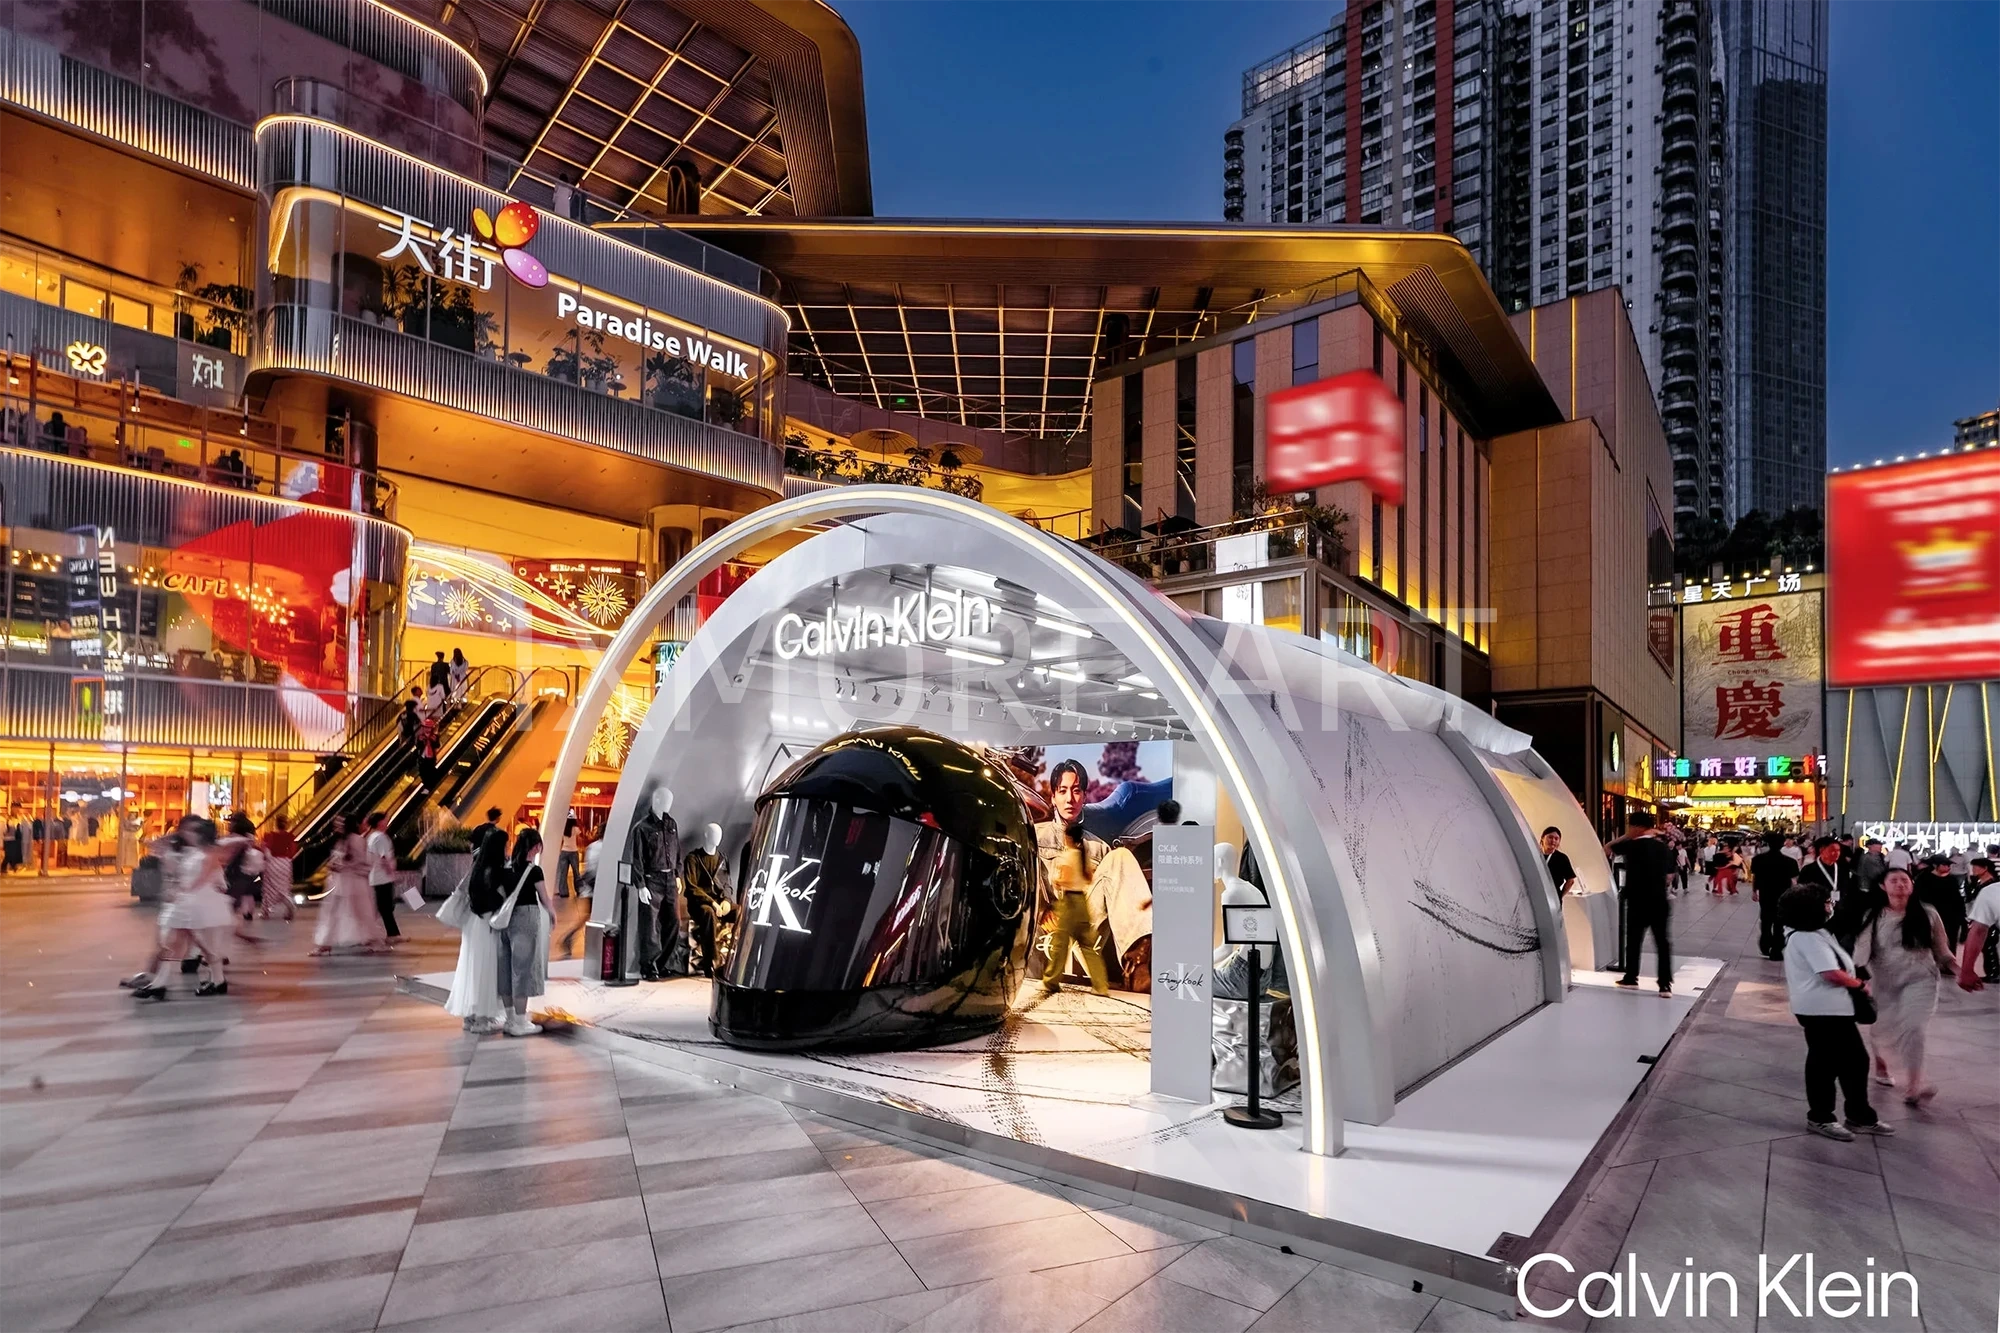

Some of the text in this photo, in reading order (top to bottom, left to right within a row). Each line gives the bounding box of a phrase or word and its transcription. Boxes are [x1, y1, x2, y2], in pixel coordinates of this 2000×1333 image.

[377, 206, 497, 291] 天街
[557, 291, 750, 380] Paradise Walk
[162, 572, 231, 598] CAFE
[1655, 573, 1801, 606] 星天广场
[775, 588, 994, 660] Calvin Klein
[1713, 603, 1787, 740] 重慶
[1157, 844, 1179, 853] CKJK
